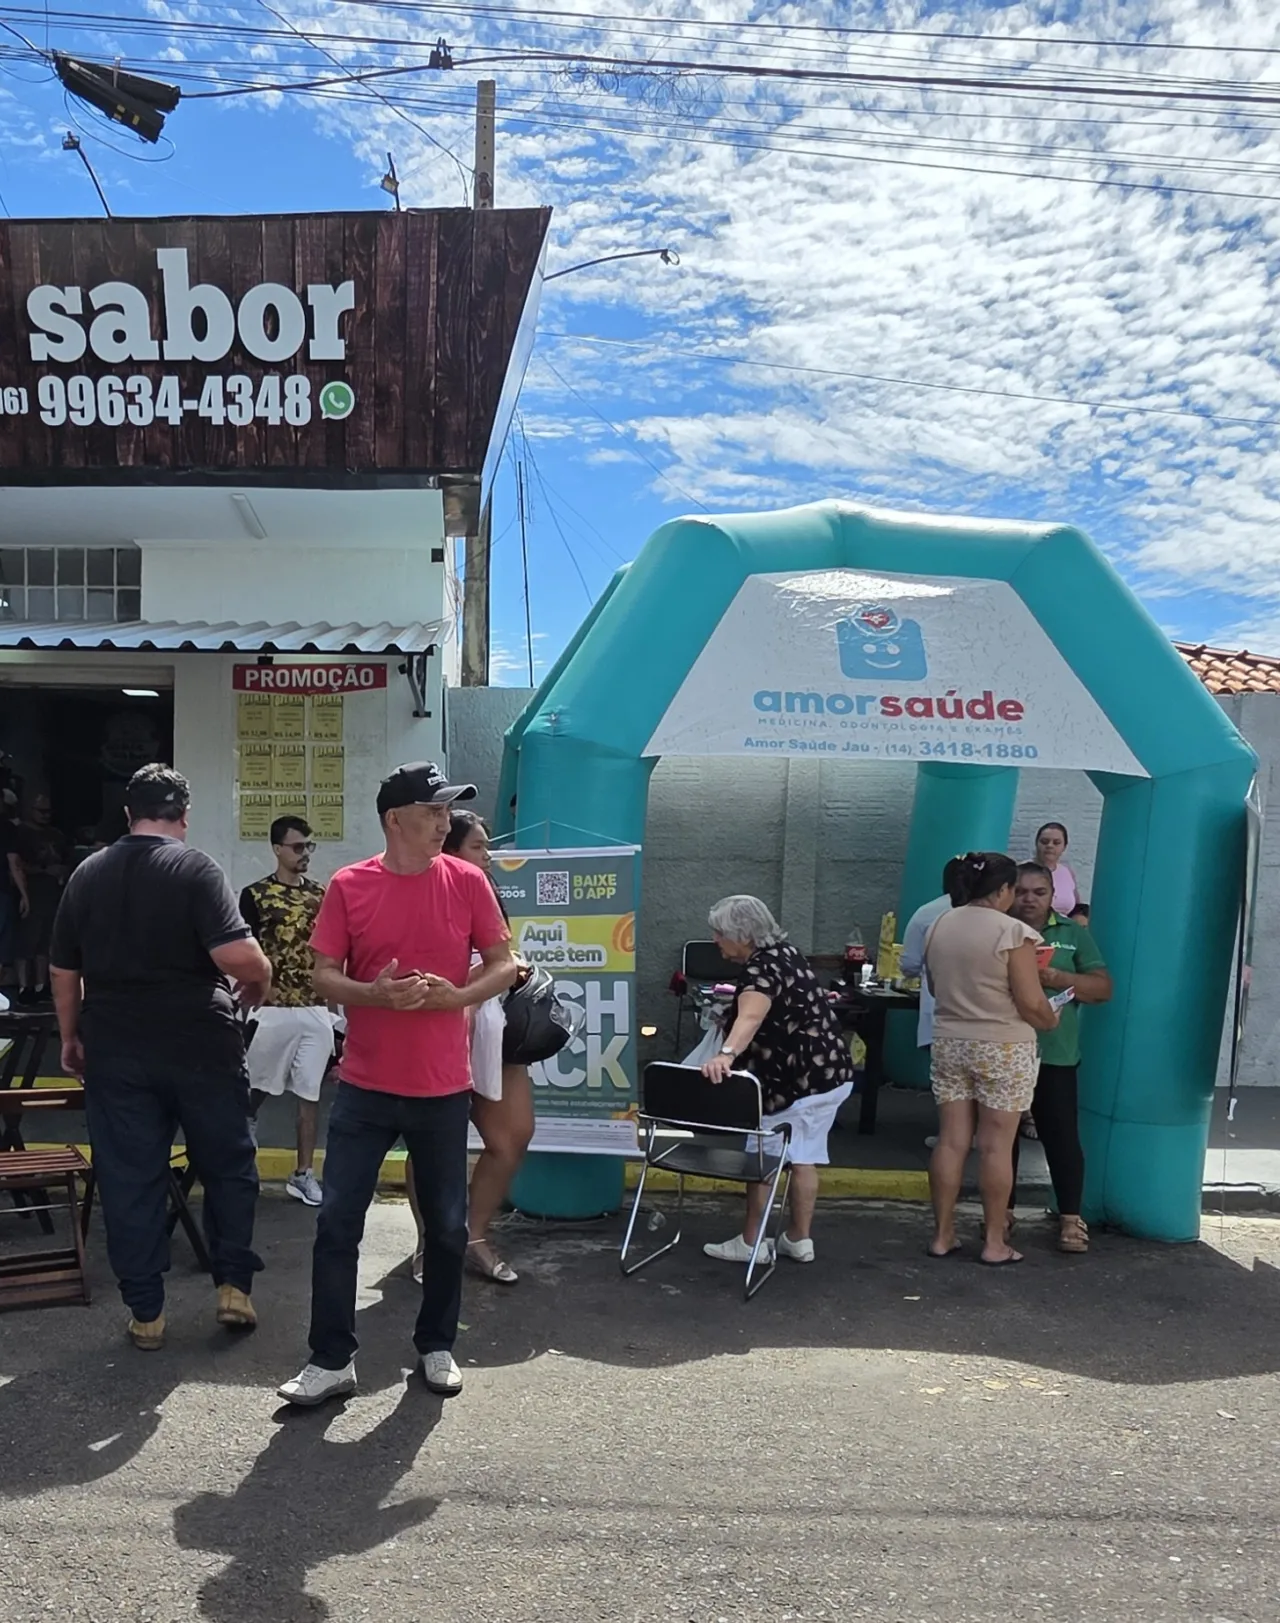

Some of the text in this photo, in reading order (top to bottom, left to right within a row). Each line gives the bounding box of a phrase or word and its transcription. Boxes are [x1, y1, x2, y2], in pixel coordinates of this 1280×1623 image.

[26, 247, 356, 364] sabor
[37, 374, 313, 428] 99634-4348
[245, 664, 375, 692] PROMOÇÃO
[753, 688, 1025, 721] amorsaúde
[744, 736, 787, 751] Amor
[787, 736, 838, 755] Saúde
[884, 742, 913, 758] (14)
[919, 739, 1039, 760] 3418-1880
[572, 873, 617, 888] BAIXE
[572, 886, 617, 900] O APP
[523, 924, 563, 946] Aqui
[523, 945, 602, 963] você tem
